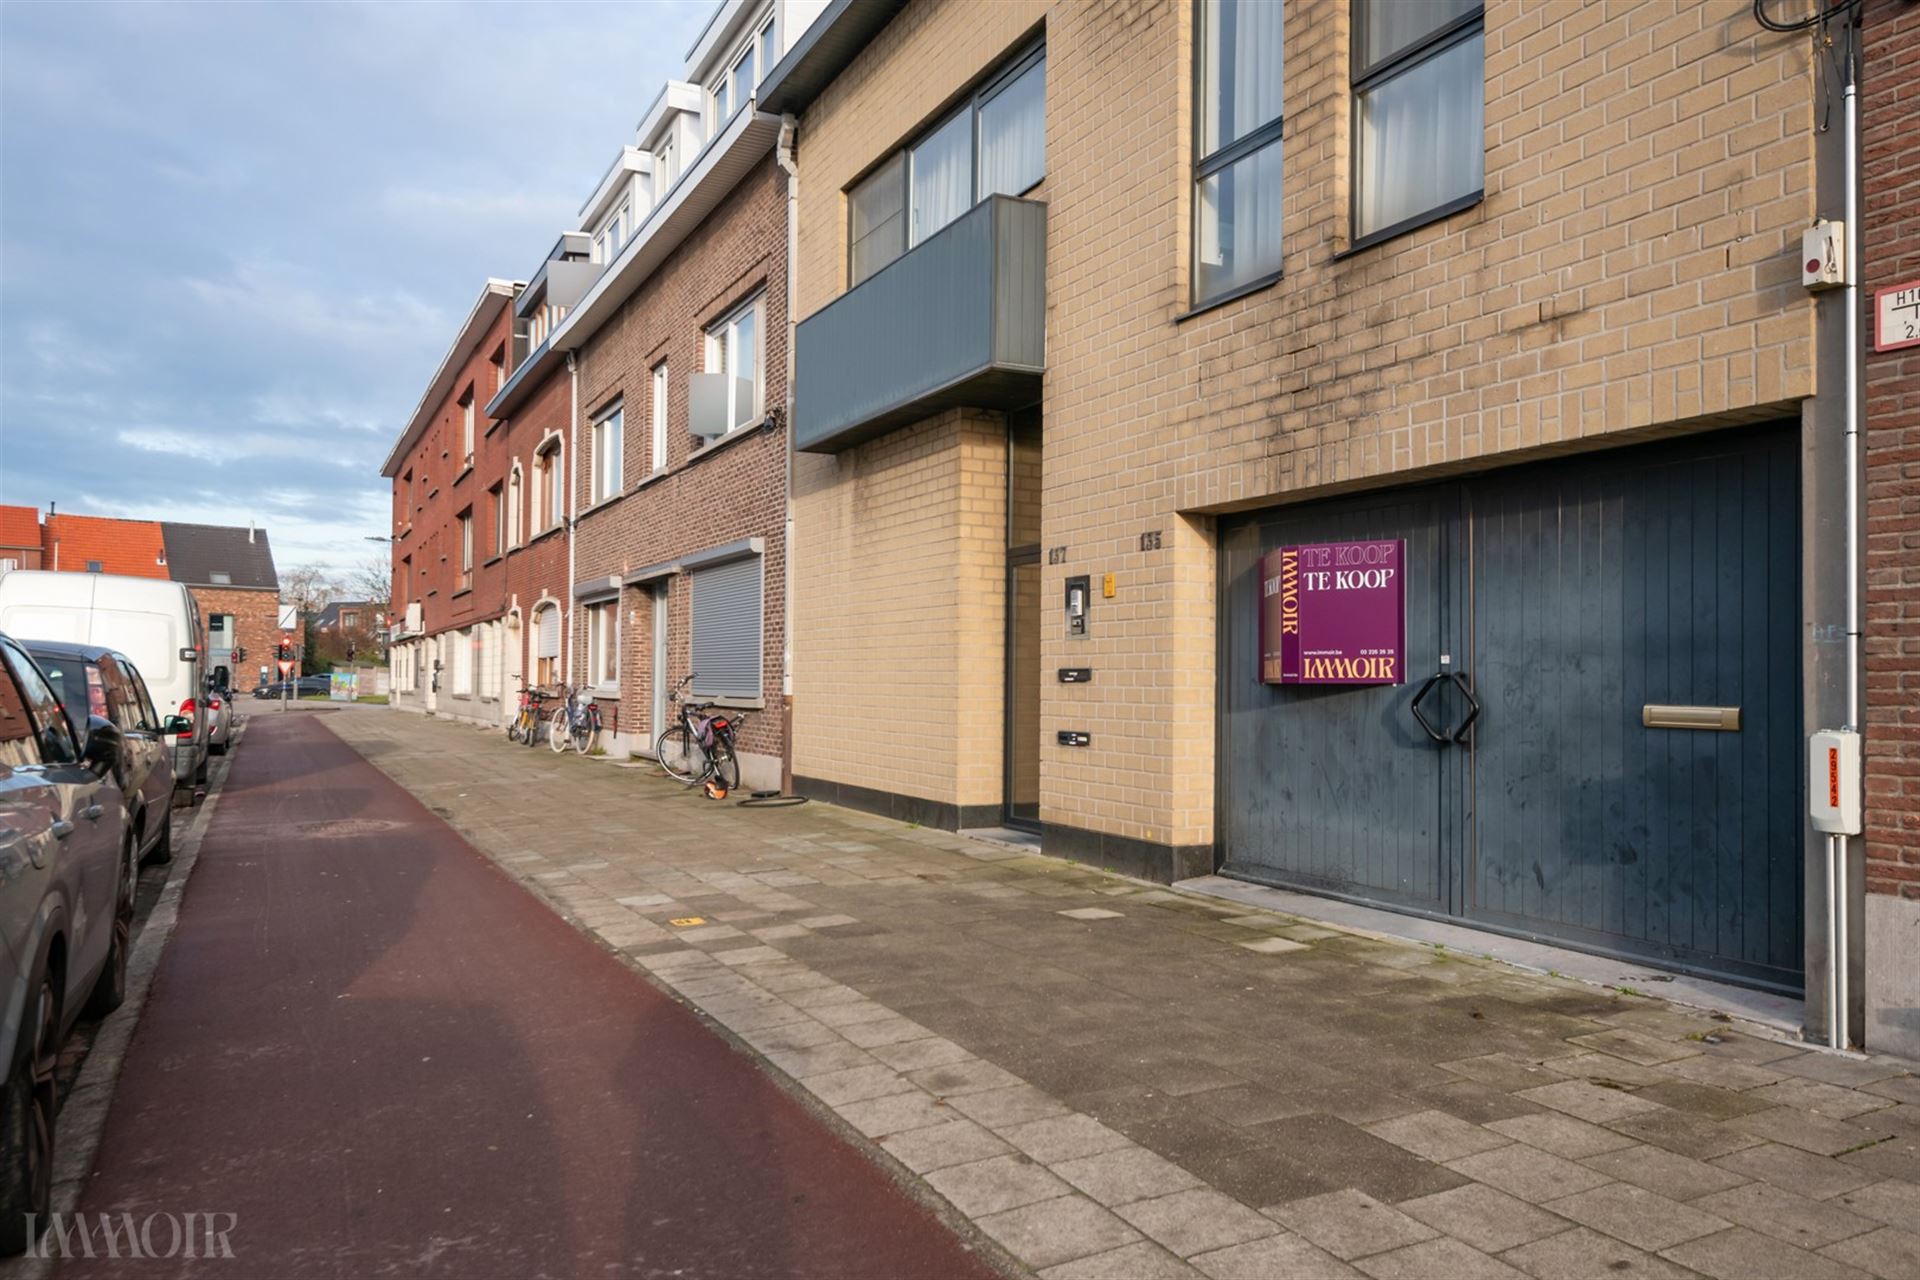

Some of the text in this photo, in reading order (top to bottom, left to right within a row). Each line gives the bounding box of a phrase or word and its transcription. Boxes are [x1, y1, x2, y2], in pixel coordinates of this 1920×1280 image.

[1897, 289, 1920, 305] H1
[1303, 544, 1394, 567] TE KOOP
[1303, 571, 1331, 591] TE
[1336, 569, 1394, 589] KOOP
[1282, 551, 1298, 635] IMMOIR
[1303, 657, 1395, 678] IMMOIR
